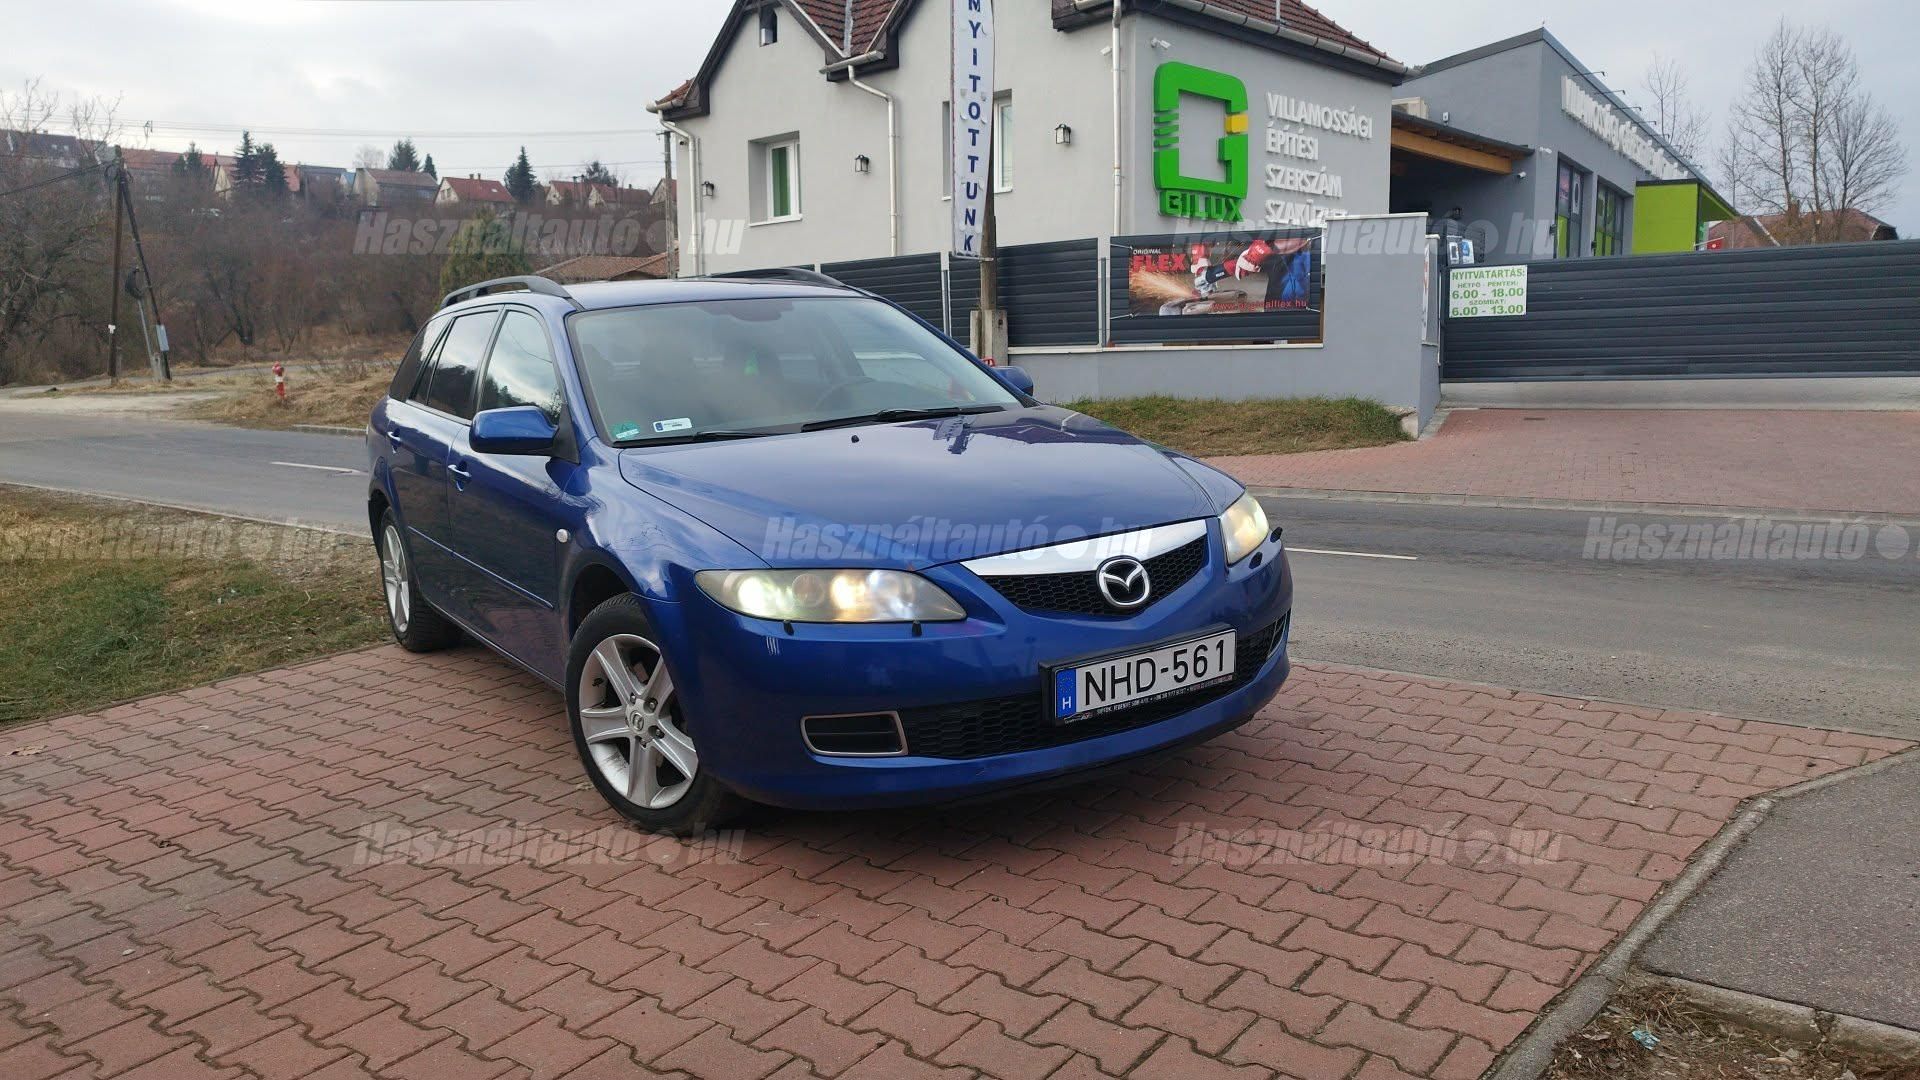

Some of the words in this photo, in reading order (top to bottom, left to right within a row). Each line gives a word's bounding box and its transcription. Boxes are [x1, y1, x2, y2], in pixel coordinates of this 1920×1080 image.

[1265, 91, 1373, 139] VILLAMOSSÁGI
[1265, 121, 1319, 160] ÉPÍTÉSI
[1264, 163, 1342, 198] SZERSZÁM
[1159, 190, 1245, 223] GILUX
[1132, 253, 1187, 273] FLEX
[1452, 289, 1479, 299] 6.00
[1491, 287, 1524, 298] 18.00
[1452, 306, 1479, 316] 6.00
[1491, 304, 1524, 314] 13.00
[1084, 640, 1225, 706] NHD-561
[1062, 696, 1072, 710] H
